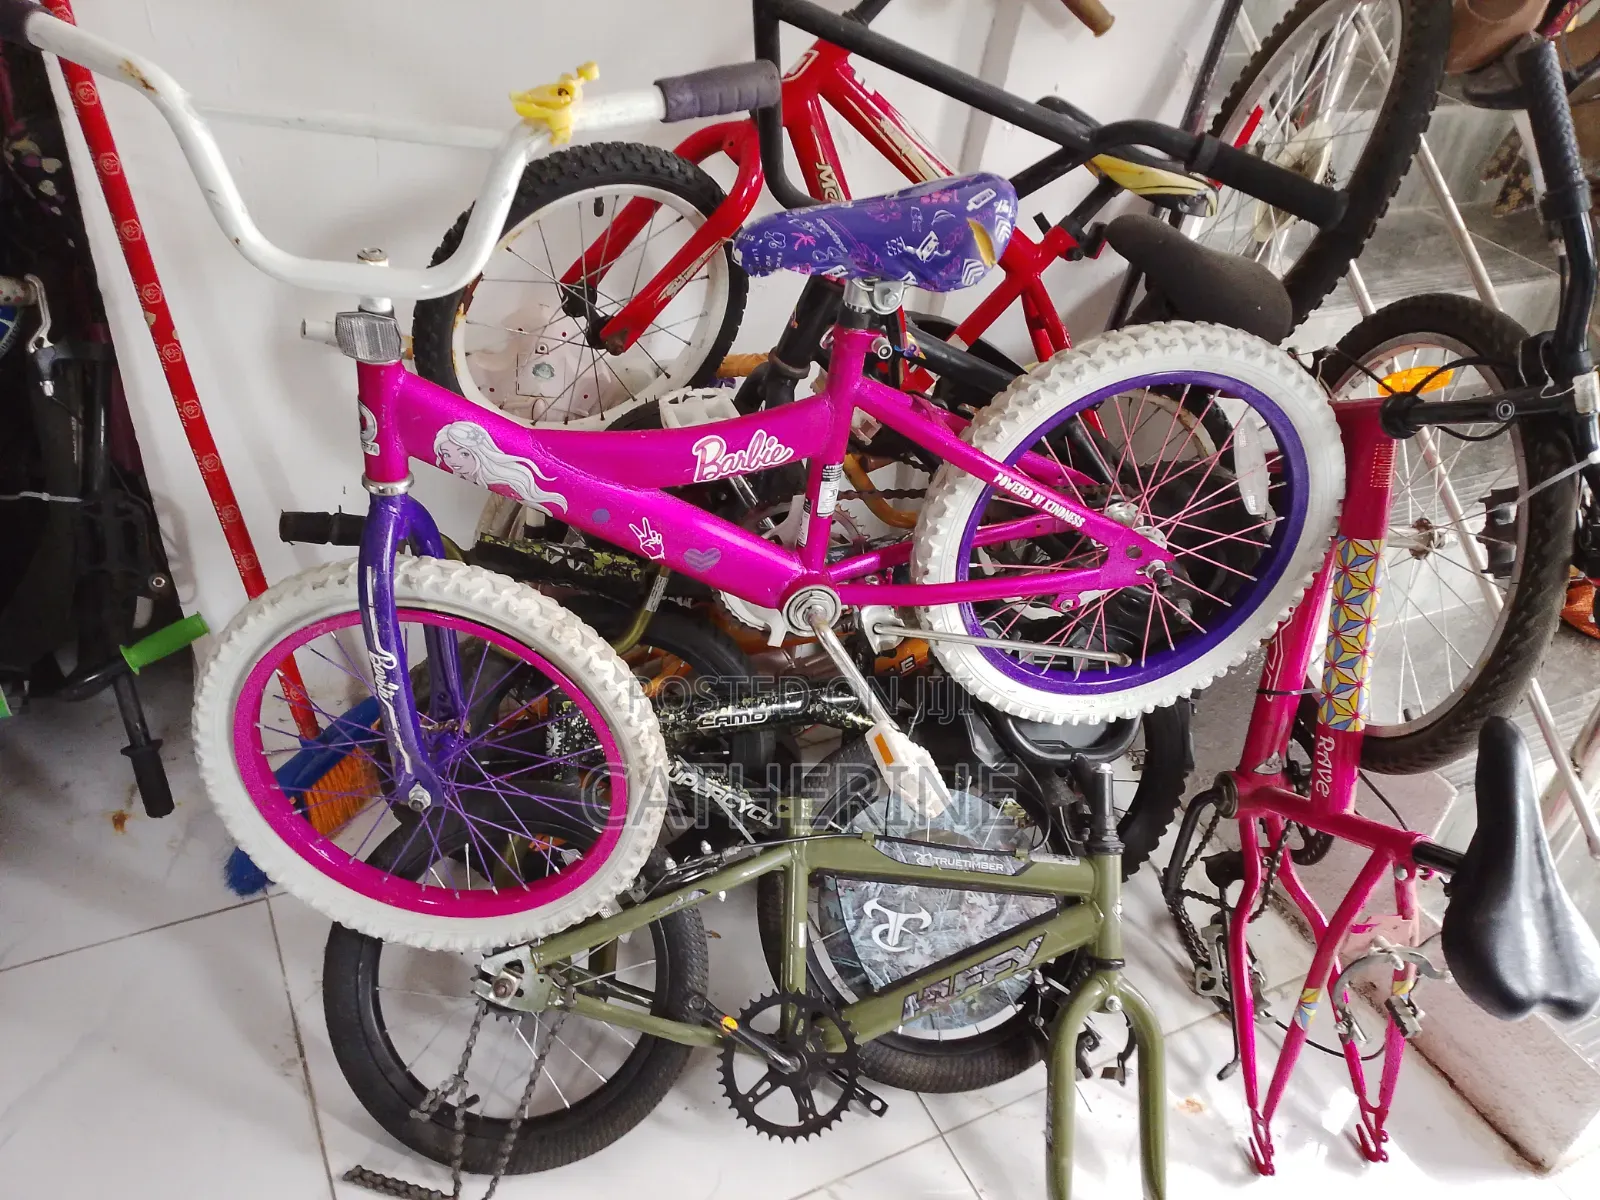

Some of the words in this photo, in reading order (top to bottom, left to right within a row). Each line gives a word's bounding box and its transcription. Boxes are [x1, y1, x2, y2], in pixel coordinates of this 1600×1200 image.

[692, 429, 794, 483] Barbie
[993, 472, 1034, 500] POWERED
[1031, 492, 1047, 506] BY
[1042, 498, 1086, 528] KINDNESS
[368, 647, 400, 701] Barbie
[933, 856, 1004, 871] TRUETIMBER
